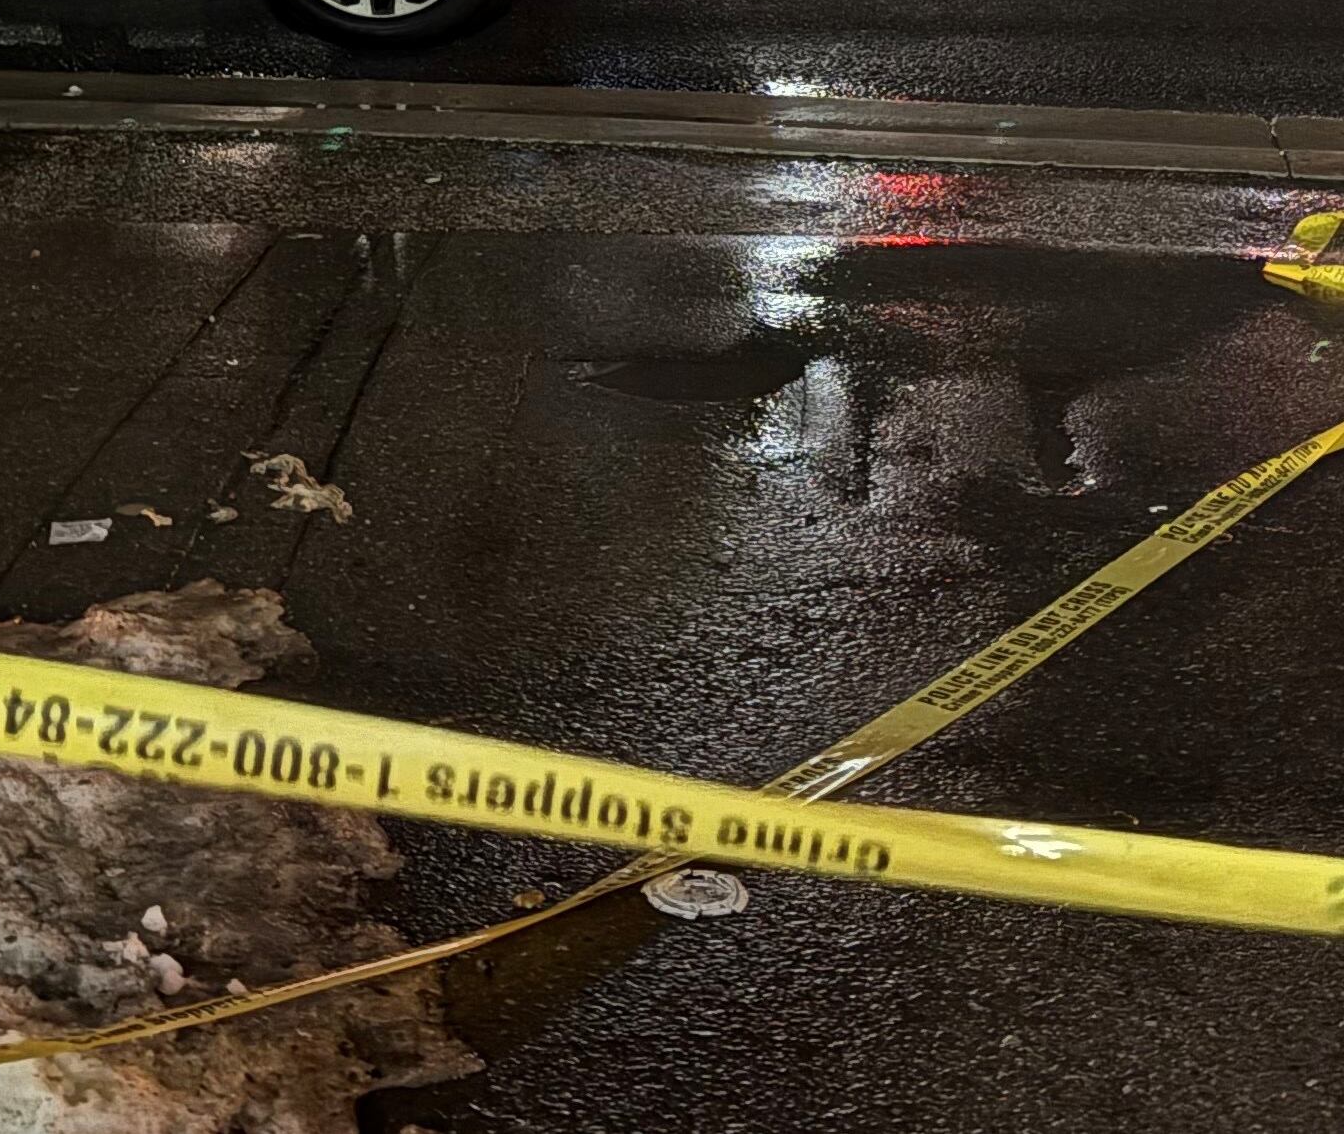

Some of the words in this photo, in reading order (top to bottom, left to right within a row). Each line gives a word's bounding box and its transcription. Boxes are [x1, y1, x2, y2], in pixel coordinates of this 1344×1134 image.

[916, 669, 983, 707] POLICE
[971, 647, 1019, 671] LINE
[1006, 632, 1040, 647] DO
[1029, 610, 1068, 632] NOT
[1059, 581, 1113, 612] CROSS
[427, 762, 693, 845] Stoppers
[714, 815, 893, 873] Crime
